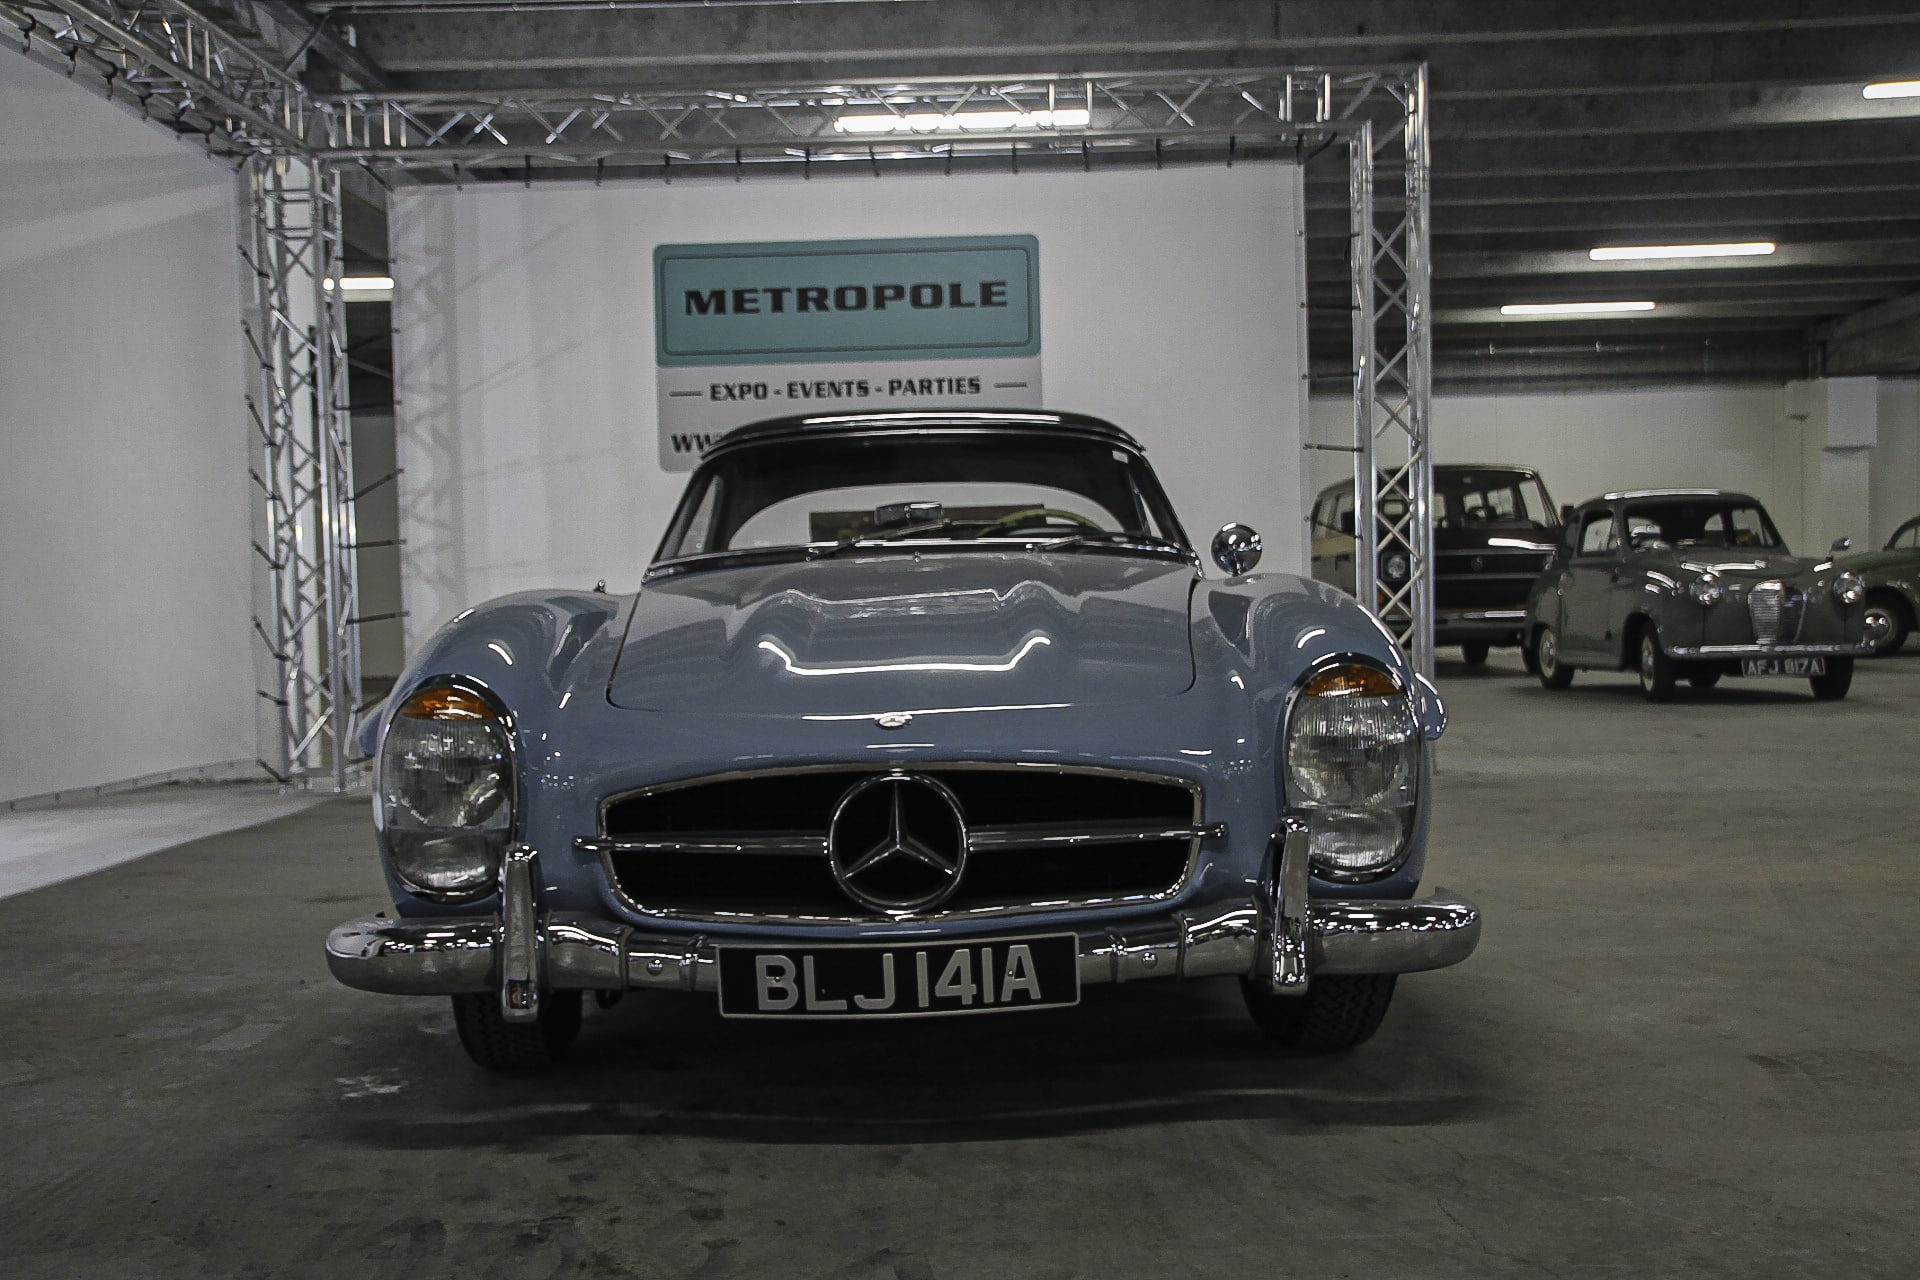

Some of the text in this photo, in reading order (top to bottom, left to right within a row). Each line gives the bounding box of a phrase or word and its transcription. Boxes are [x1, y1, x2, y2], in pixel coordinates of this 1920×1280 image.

[684, 281, 1008, 316] METROPOLE
[710, 383, 768, 401] EXPO
[786, 380, 869, 399] EVENTS
[888, 377, 982, 395] PARTIES
[755, 944, 1042, 1011] BLJ 141A
